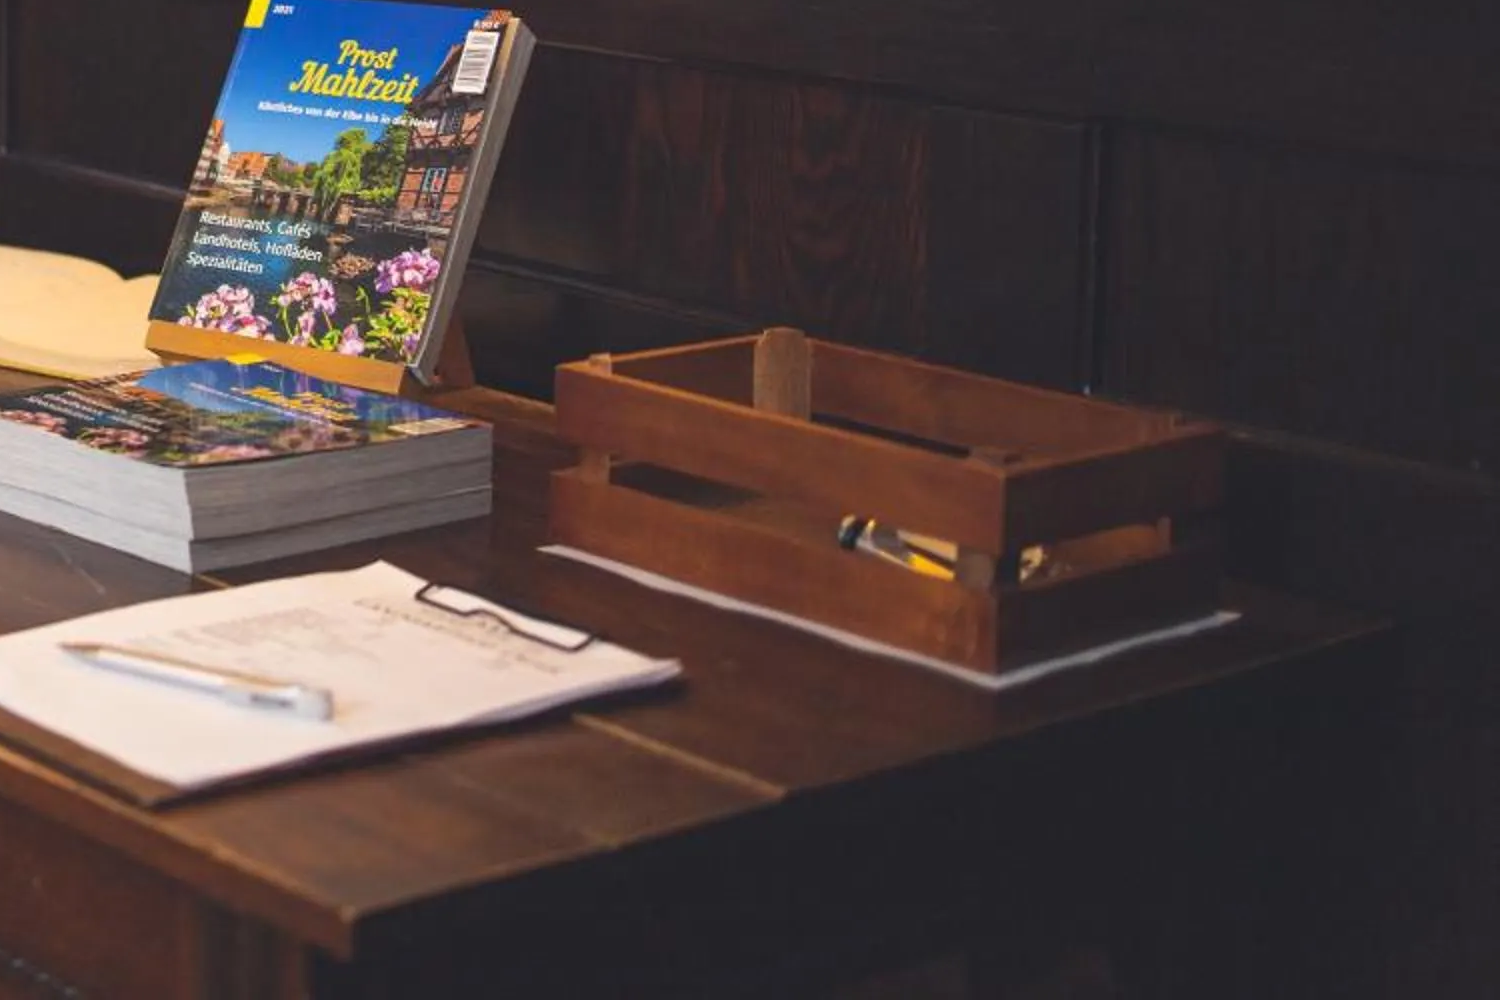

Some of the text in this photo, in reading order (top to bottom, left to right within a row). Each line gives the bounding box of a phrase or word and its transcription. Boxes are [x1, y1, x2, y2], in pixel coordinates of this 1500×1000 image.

[336, 39, 399, 70] Prost
[288, 60, 420, 105] Mahlzeit
[199, 211, 313, 239] Restaurants, Cafés
[193, 231, 323, 262] Landhotels, Hofläden
[186, 251, 264, 274] Spezialitäten
